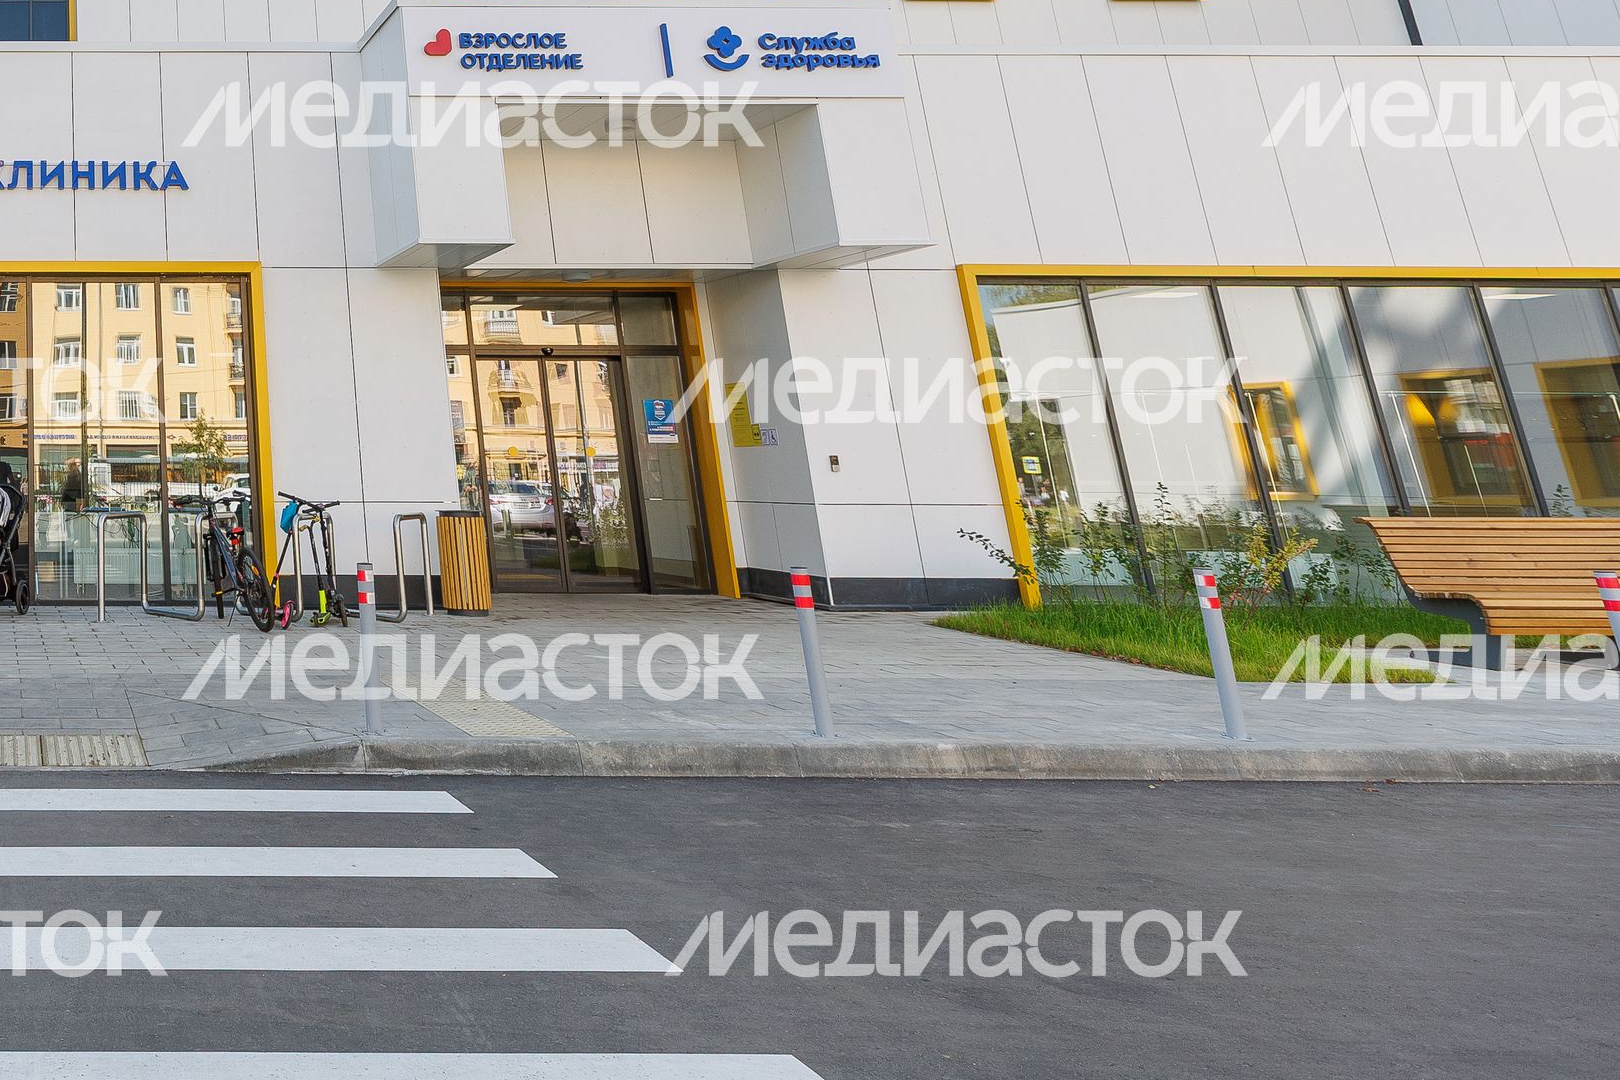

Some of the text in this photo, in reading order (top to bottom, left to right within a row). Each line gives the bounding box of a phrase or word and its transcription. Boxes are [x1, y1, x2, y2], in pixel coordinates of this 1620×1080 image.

[458, 32, 568, 49] ВЗРОСЛОЕ
[757, 31, 857, 54] Служба
[460, 53, 584, 72] ОТДЕЛЕНИЕ
[760, 53, 881, 72] здоровья
